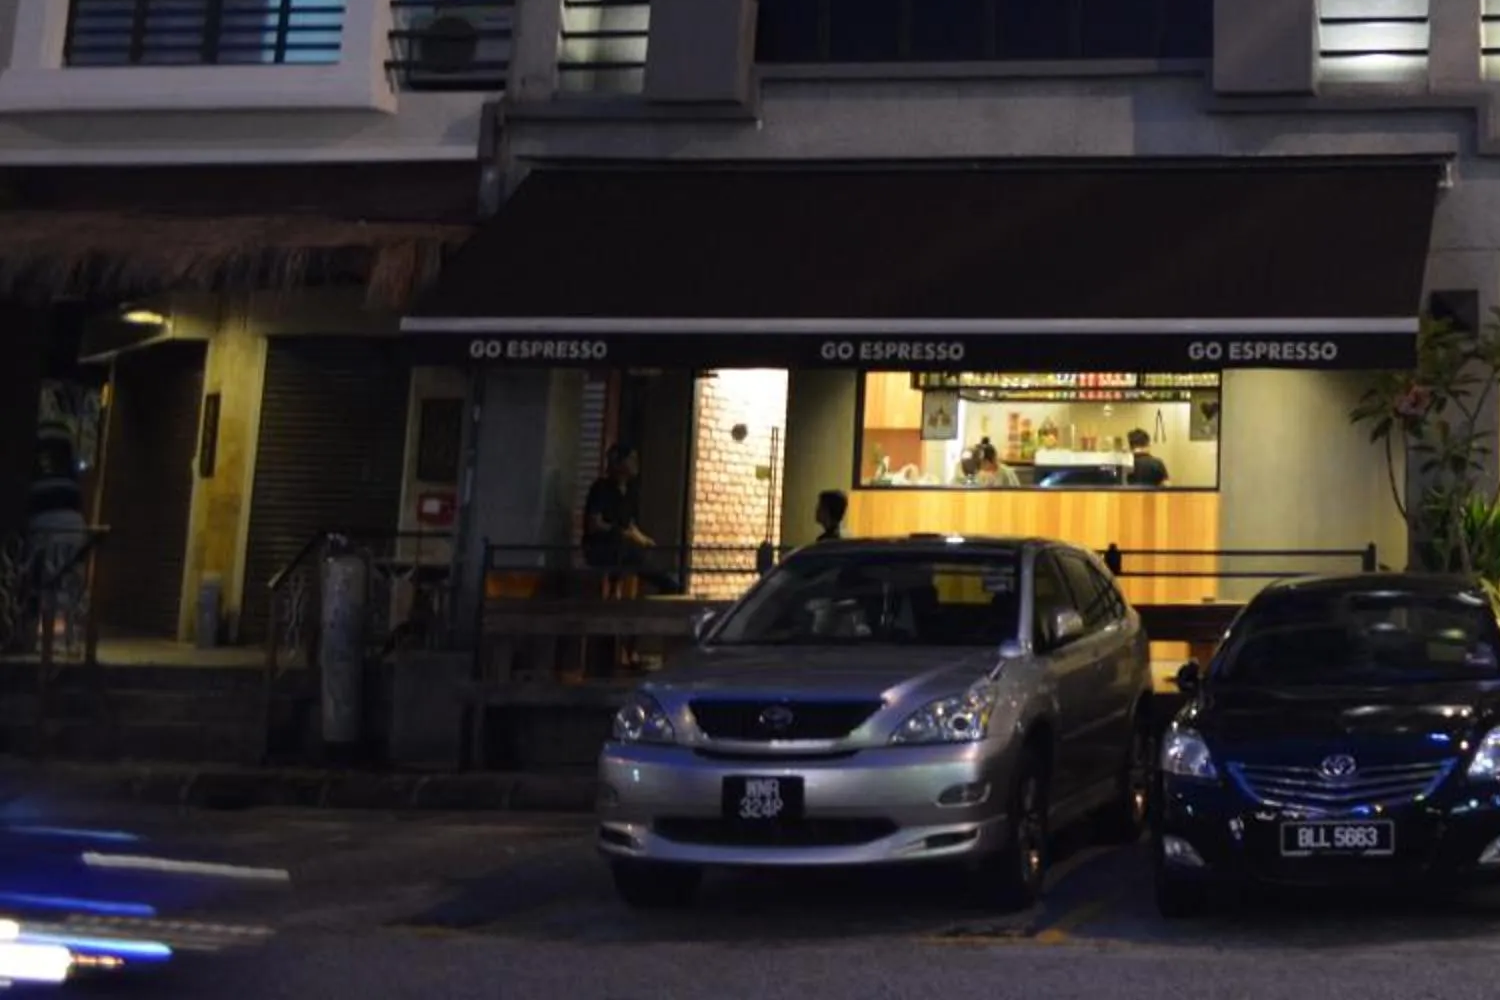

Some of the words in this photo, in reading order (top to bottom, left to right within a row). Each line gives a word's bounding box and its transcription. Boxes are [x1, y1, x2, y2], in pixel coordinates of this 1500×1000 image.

[470, 340, 501, 358] GO
[507, 340, 608, 358] ESPRESSO
[821, 342, 854, 360] GO
[860, 342, 965, 360] ESPRESSO
[1188, 342, 1222, 360] GO
[1229, 342, 1338, 360] ESPRESSO
[1298, 827, 1331, 848] BLL
